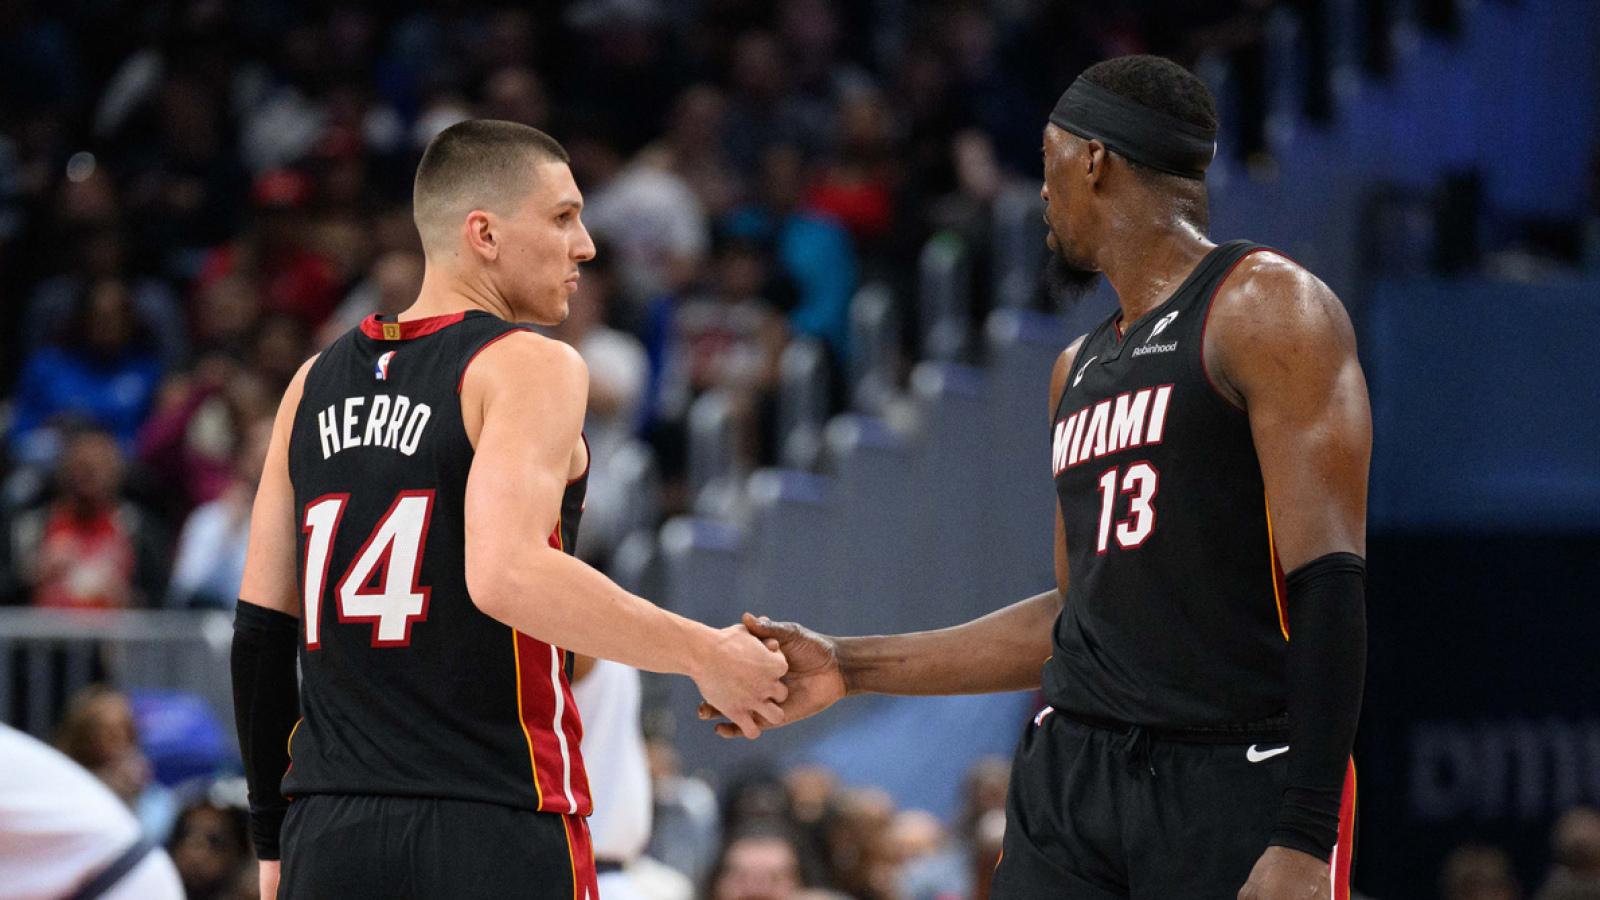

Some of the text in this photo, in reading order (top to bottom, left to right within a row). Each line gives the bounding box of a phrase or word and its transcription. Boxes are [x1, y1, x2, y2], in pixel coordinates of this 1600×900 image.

[1132, 341, 1178, 357] Robinhood
[318, 394, 432, 460] HERRO
[1052, 383, 1175, 479] MIAMI
[1096, 460, 1159, 556] 13
[302, 489, 436, 651] 14
